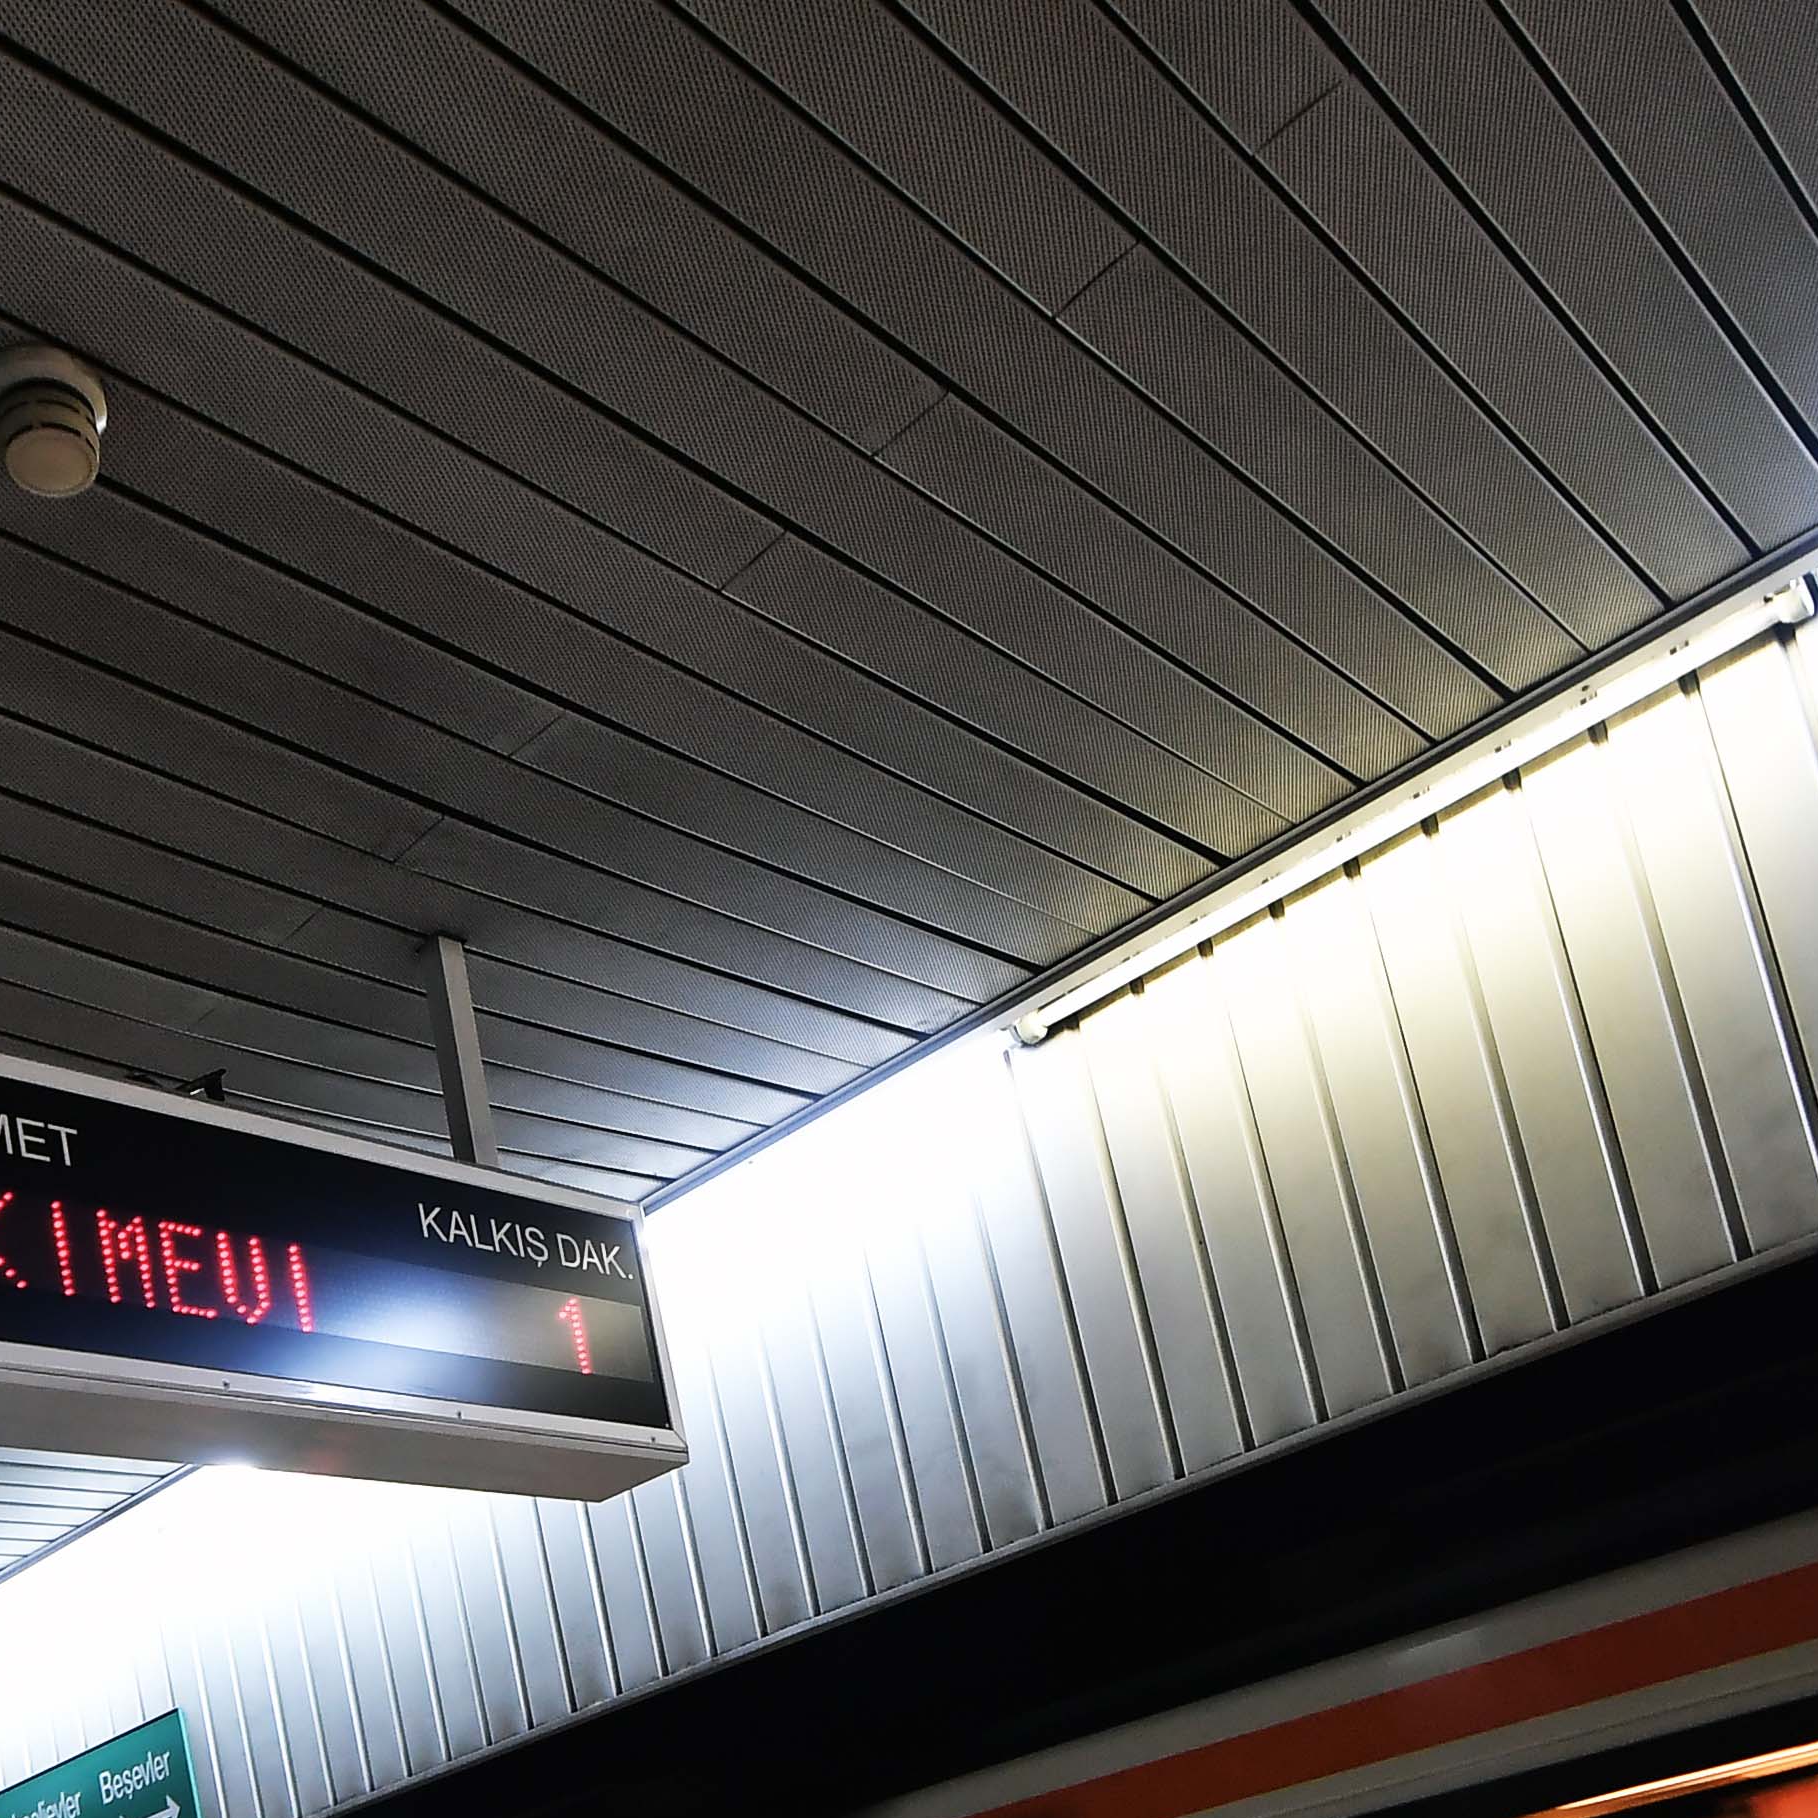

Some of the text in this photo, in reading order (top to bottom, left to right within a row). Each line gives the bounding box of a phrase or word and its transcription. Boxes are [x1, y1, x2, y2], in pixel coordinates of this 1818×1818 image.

[417, 1202, 634, 1280] KALKIŞ DAK.
[557, 1297, 593, 1375] 1
[99, 1751, 170, 1804] Beşevler
